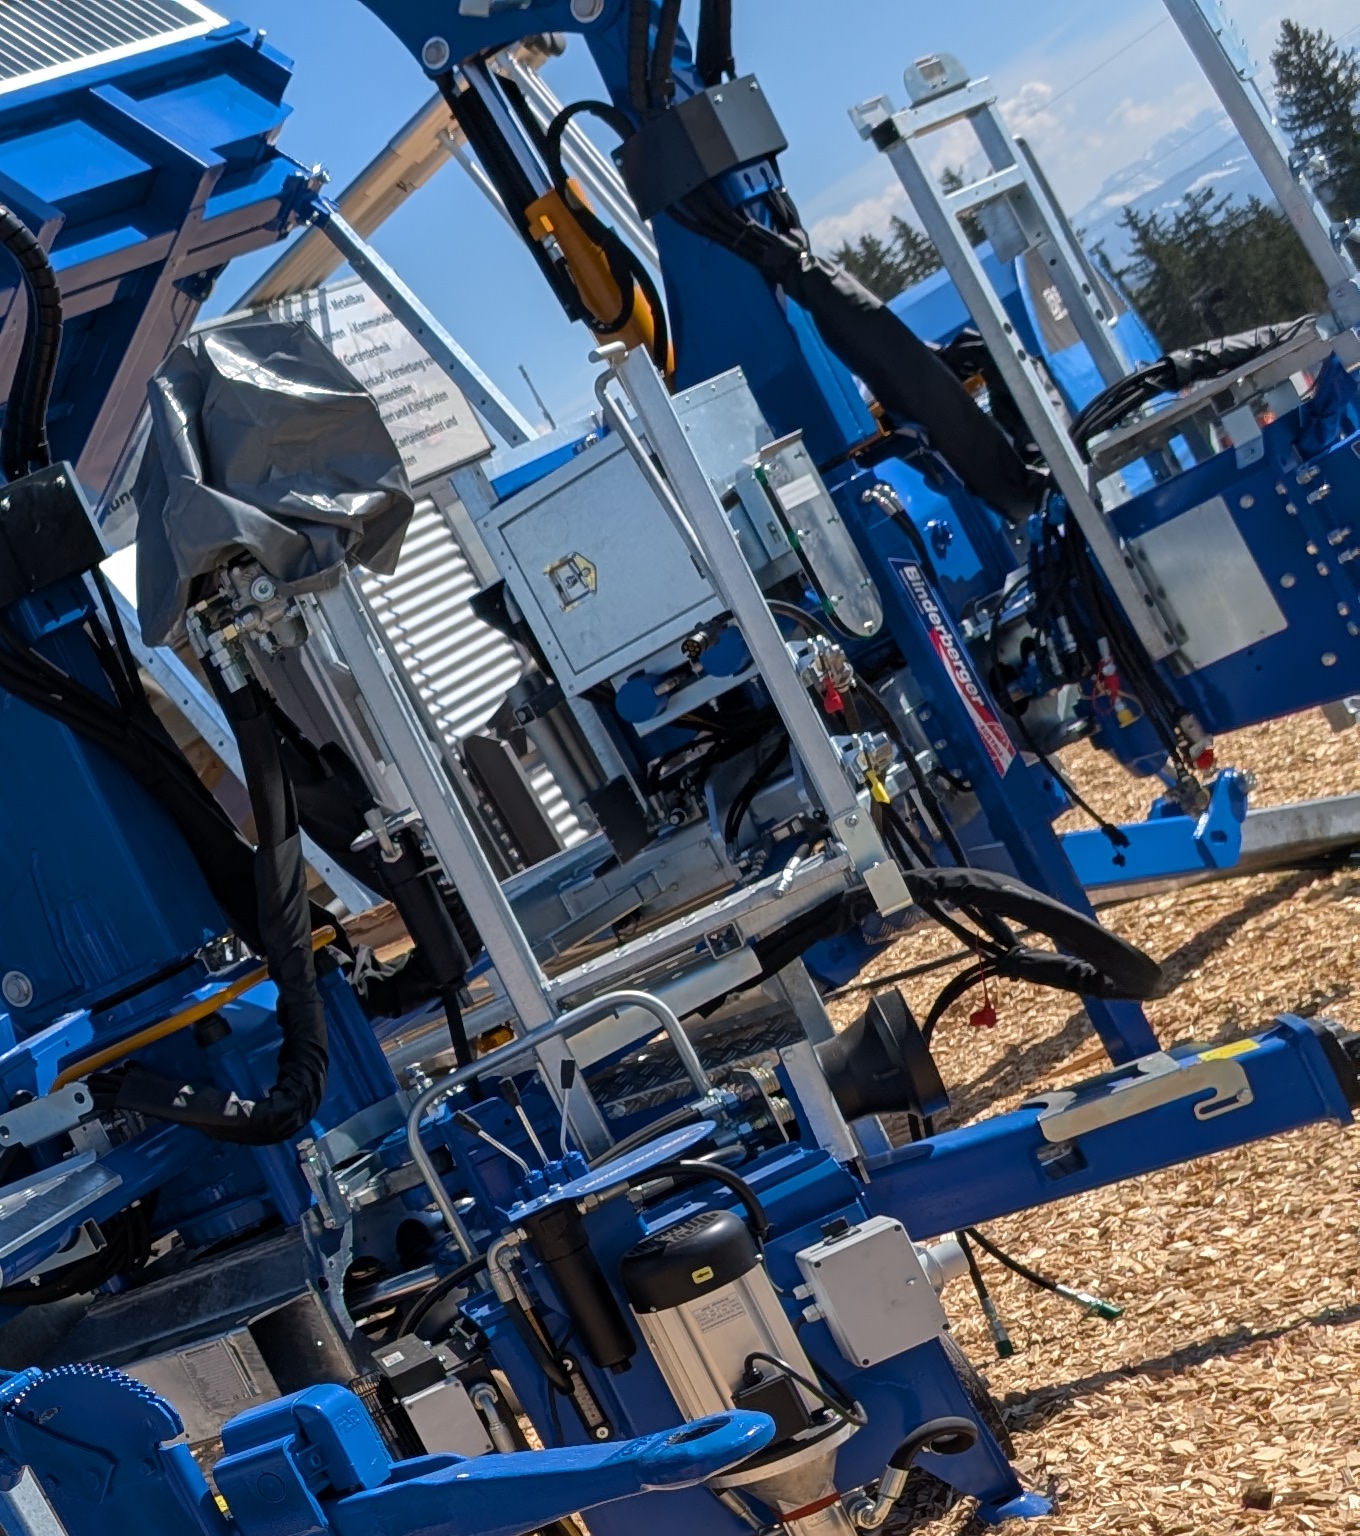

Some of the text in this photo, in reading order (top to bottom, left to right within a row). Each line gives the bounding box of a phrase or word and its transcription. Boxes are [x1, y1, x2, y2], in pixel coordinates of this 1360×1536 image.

[331, 294, 365, 311] Metallbau
[343, 341, 392, 367] Gartentechnik
[395, 405, 408, 420] und
[445, 414, 458, 429] und
[903, 565, 985, 707] Binderberger
